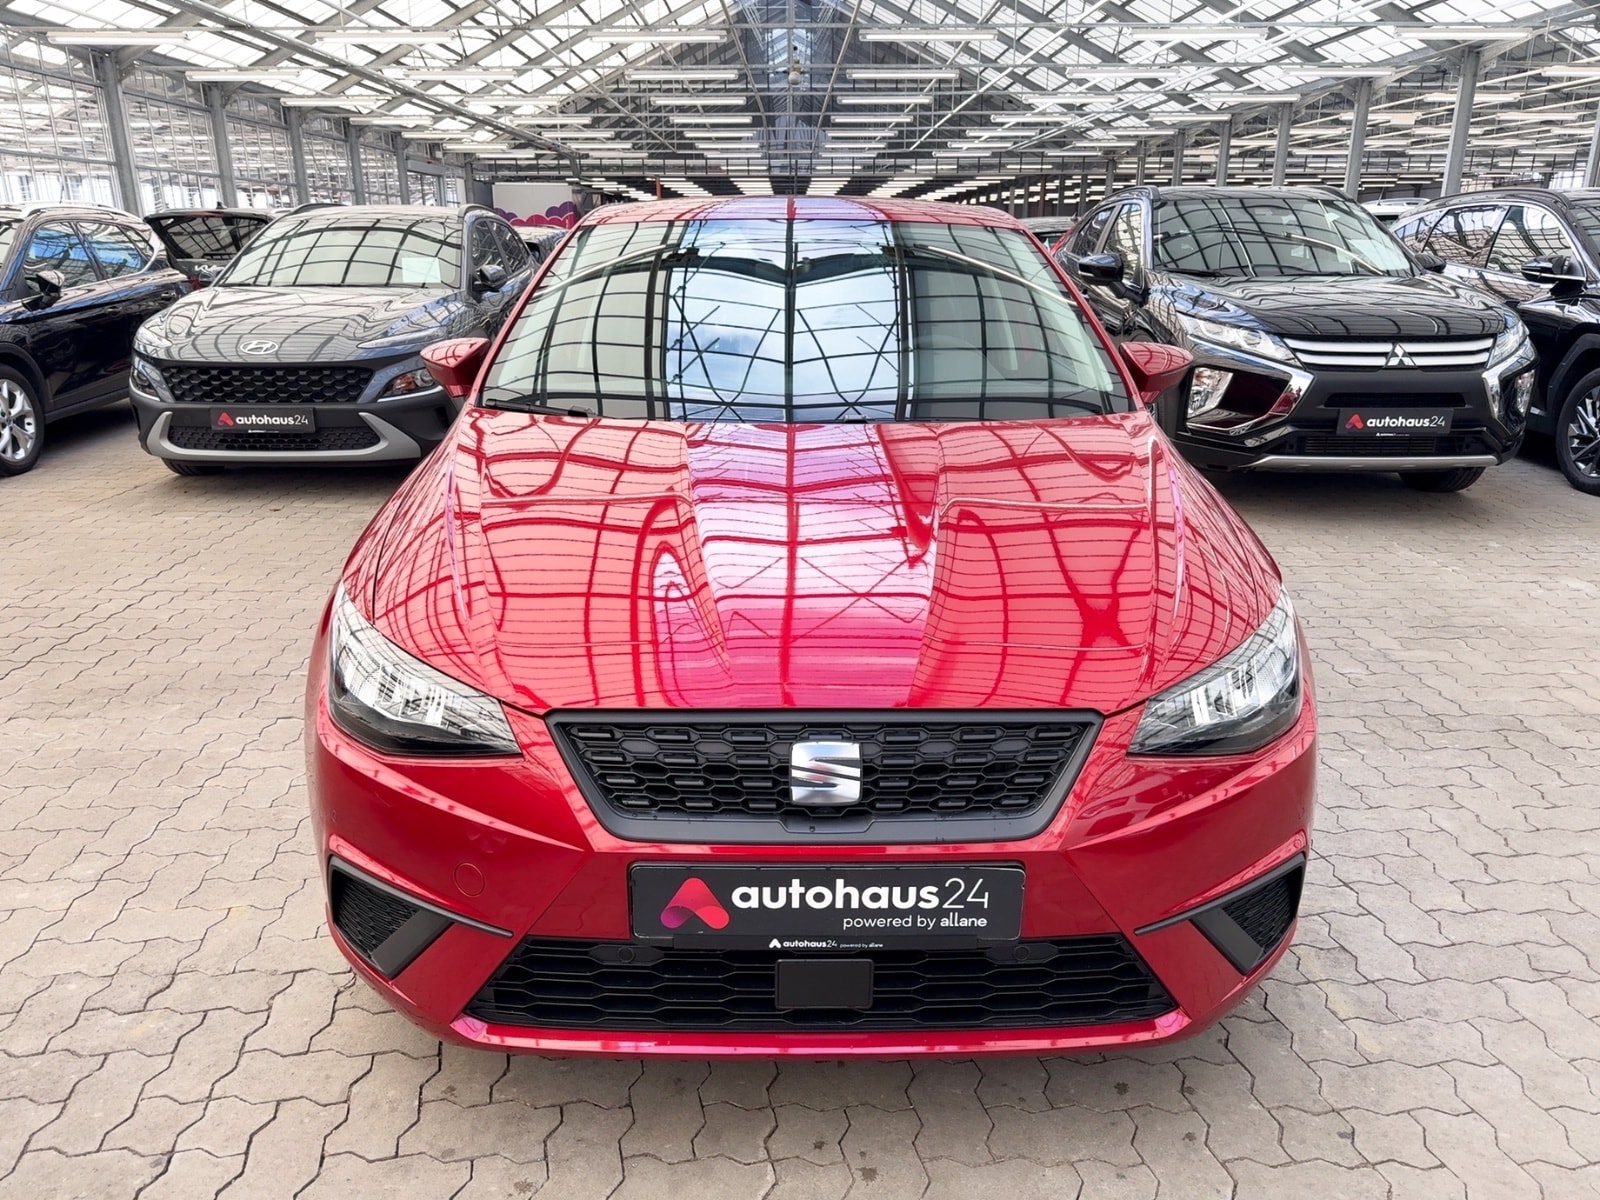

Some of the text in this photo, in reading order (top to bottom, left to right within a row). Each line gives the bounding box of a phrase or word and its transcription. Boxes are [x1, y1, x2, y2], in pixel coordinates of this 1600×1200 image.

[235, 414, 309, 425] autohaus24
[1366, 415, 1446, 427] autohaus24
[731, 877, 989, 909] autohaus24
[843, 912, 988, 931] powered by allane
[783, 940, 837, 948] autohaus24
